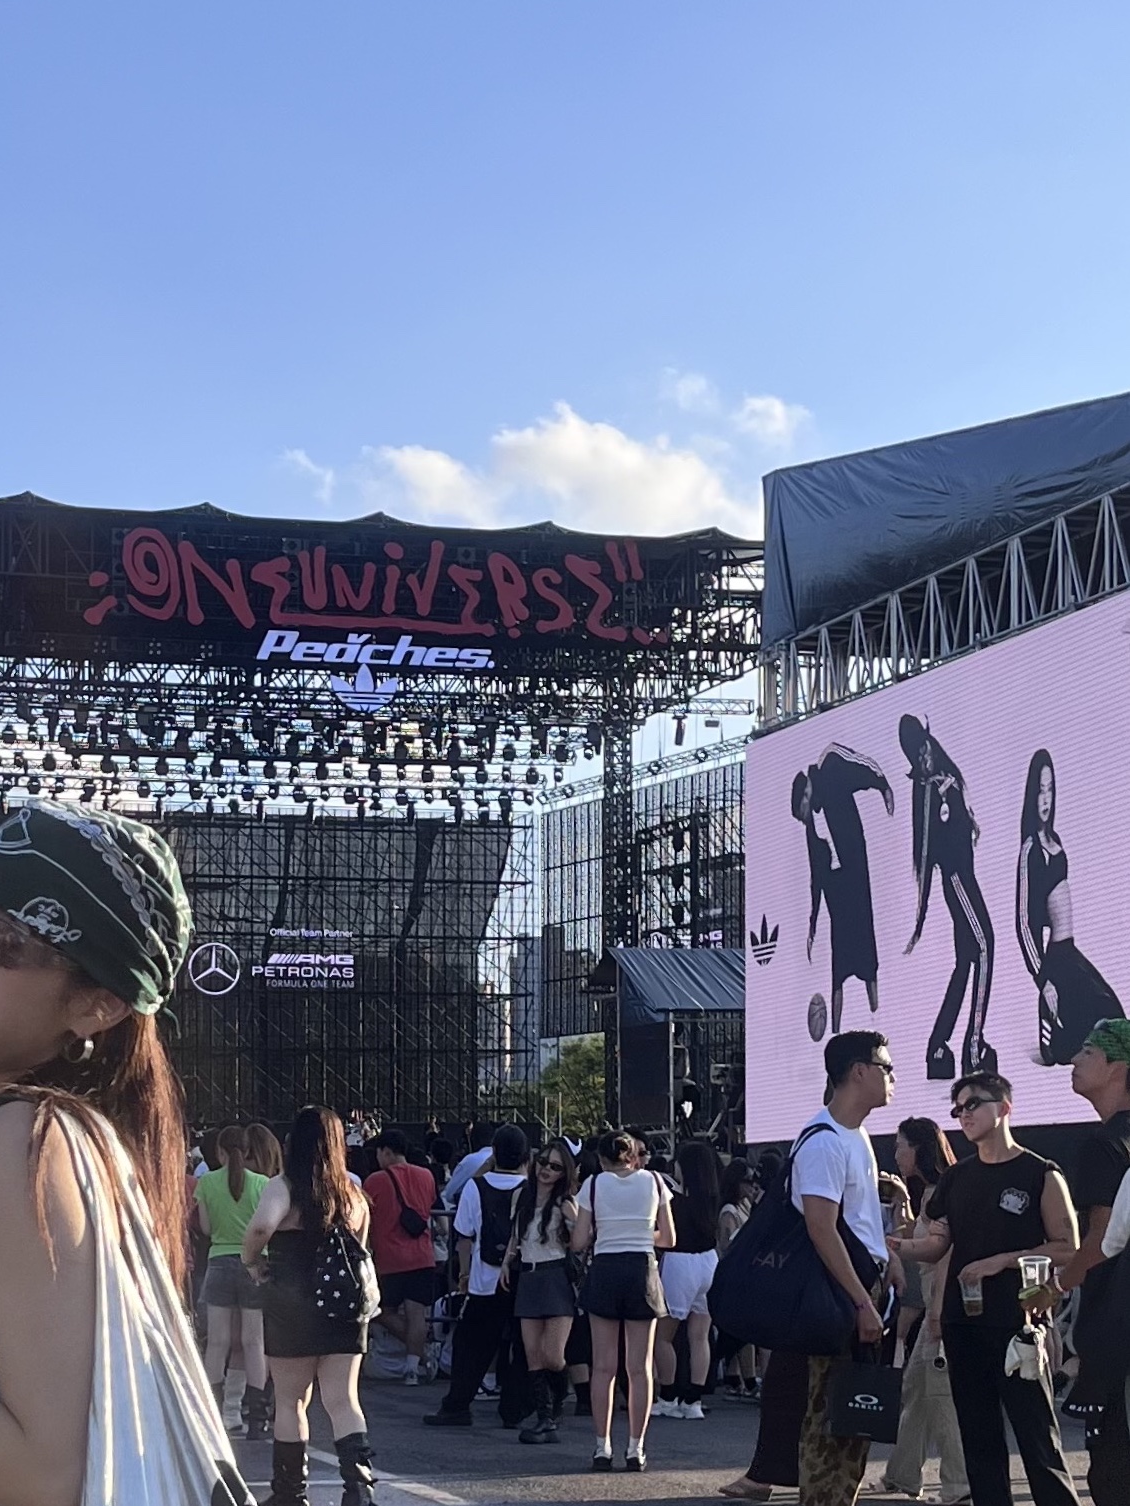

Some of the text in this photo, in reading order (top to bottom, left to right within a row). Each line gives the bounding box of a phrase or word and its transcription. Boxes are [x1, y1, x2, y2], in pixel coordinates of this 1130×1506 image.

[270, 928, 353, 938] Official Team Partner
[251, 966, 355, 978] PETRONAS
[266, 979, 355, 988] FORMULA ONE TEAM
